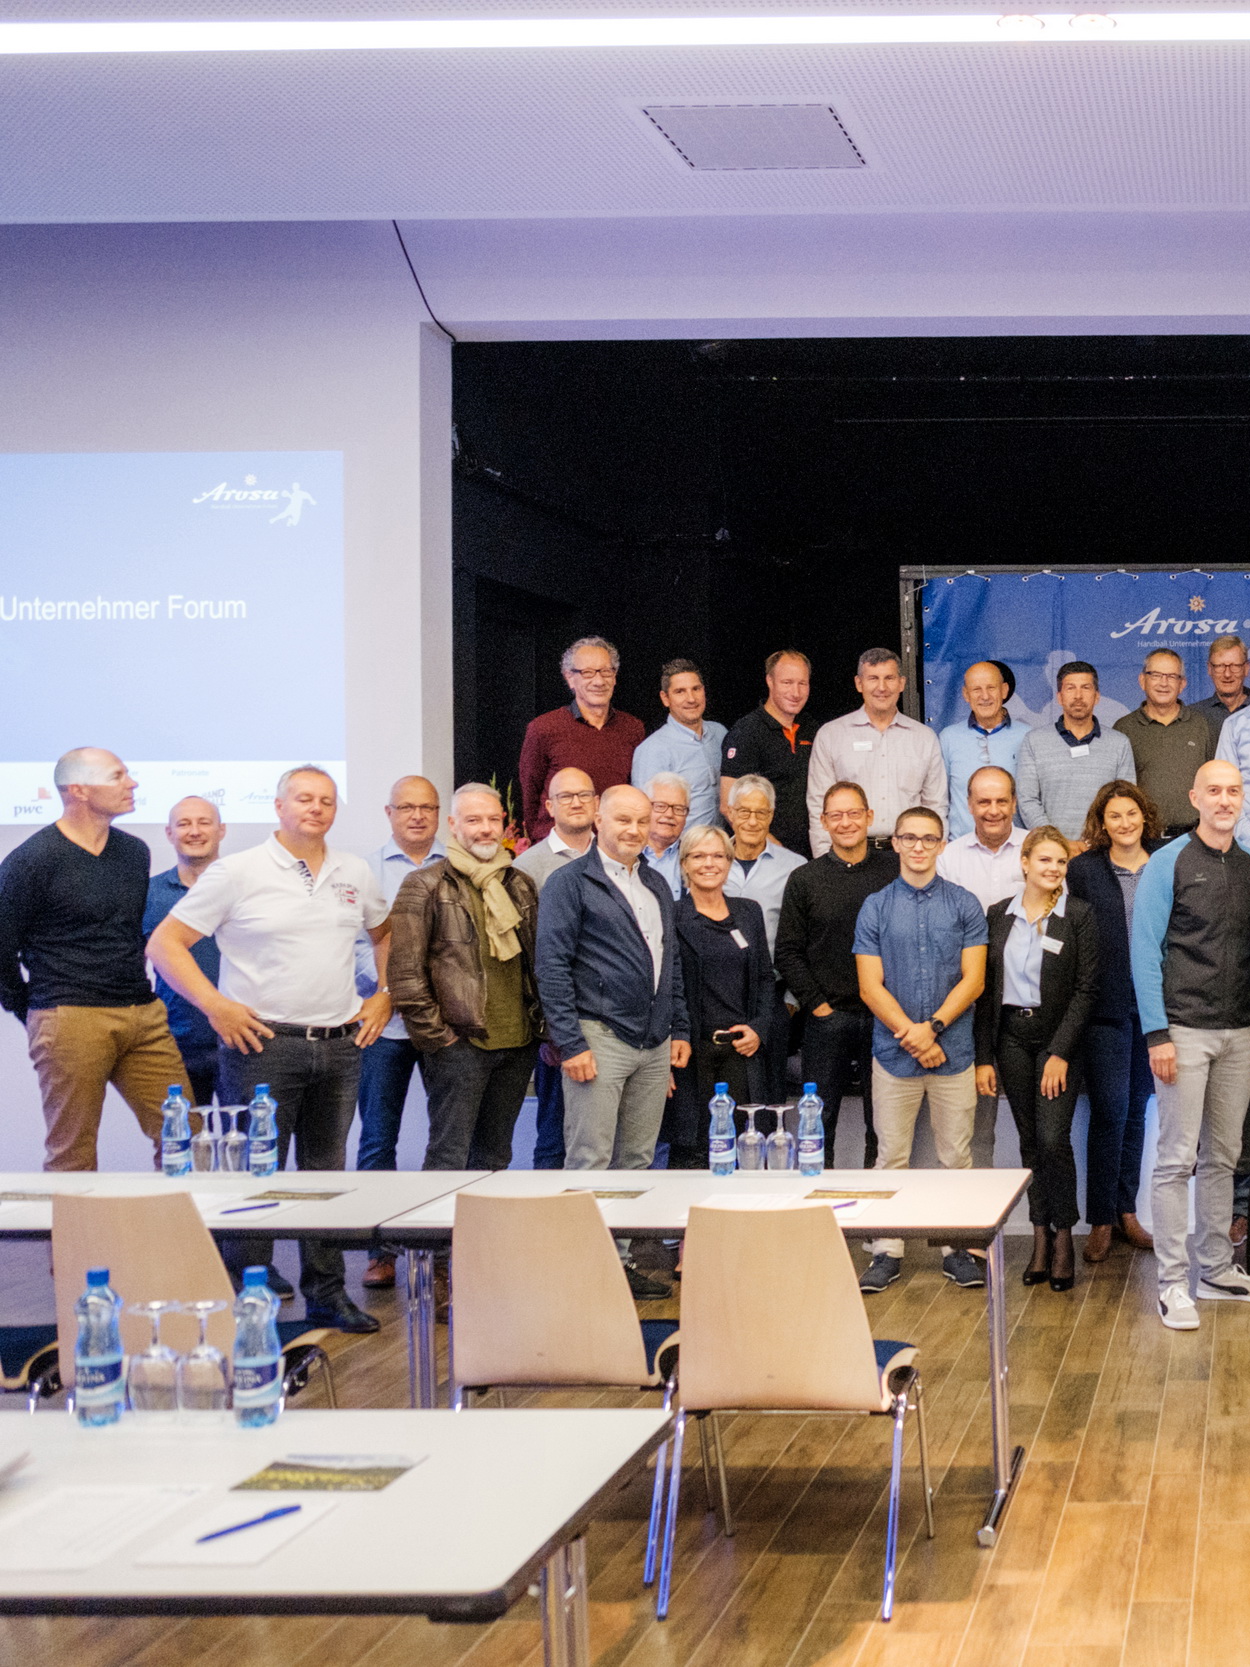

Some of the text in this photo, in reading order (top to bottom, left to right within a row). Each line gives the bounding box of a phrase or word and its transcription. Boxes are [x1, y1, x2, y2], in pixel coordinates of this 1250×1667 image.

[192, 482, 279, 503] Arosa
[0, 594, 247, 621] Unternehmer Forum
[1110, 607, 1239, 639] Arosa
[1137, 640, 1168, 648] Handball
[14, 805, 43, 818] pwc
